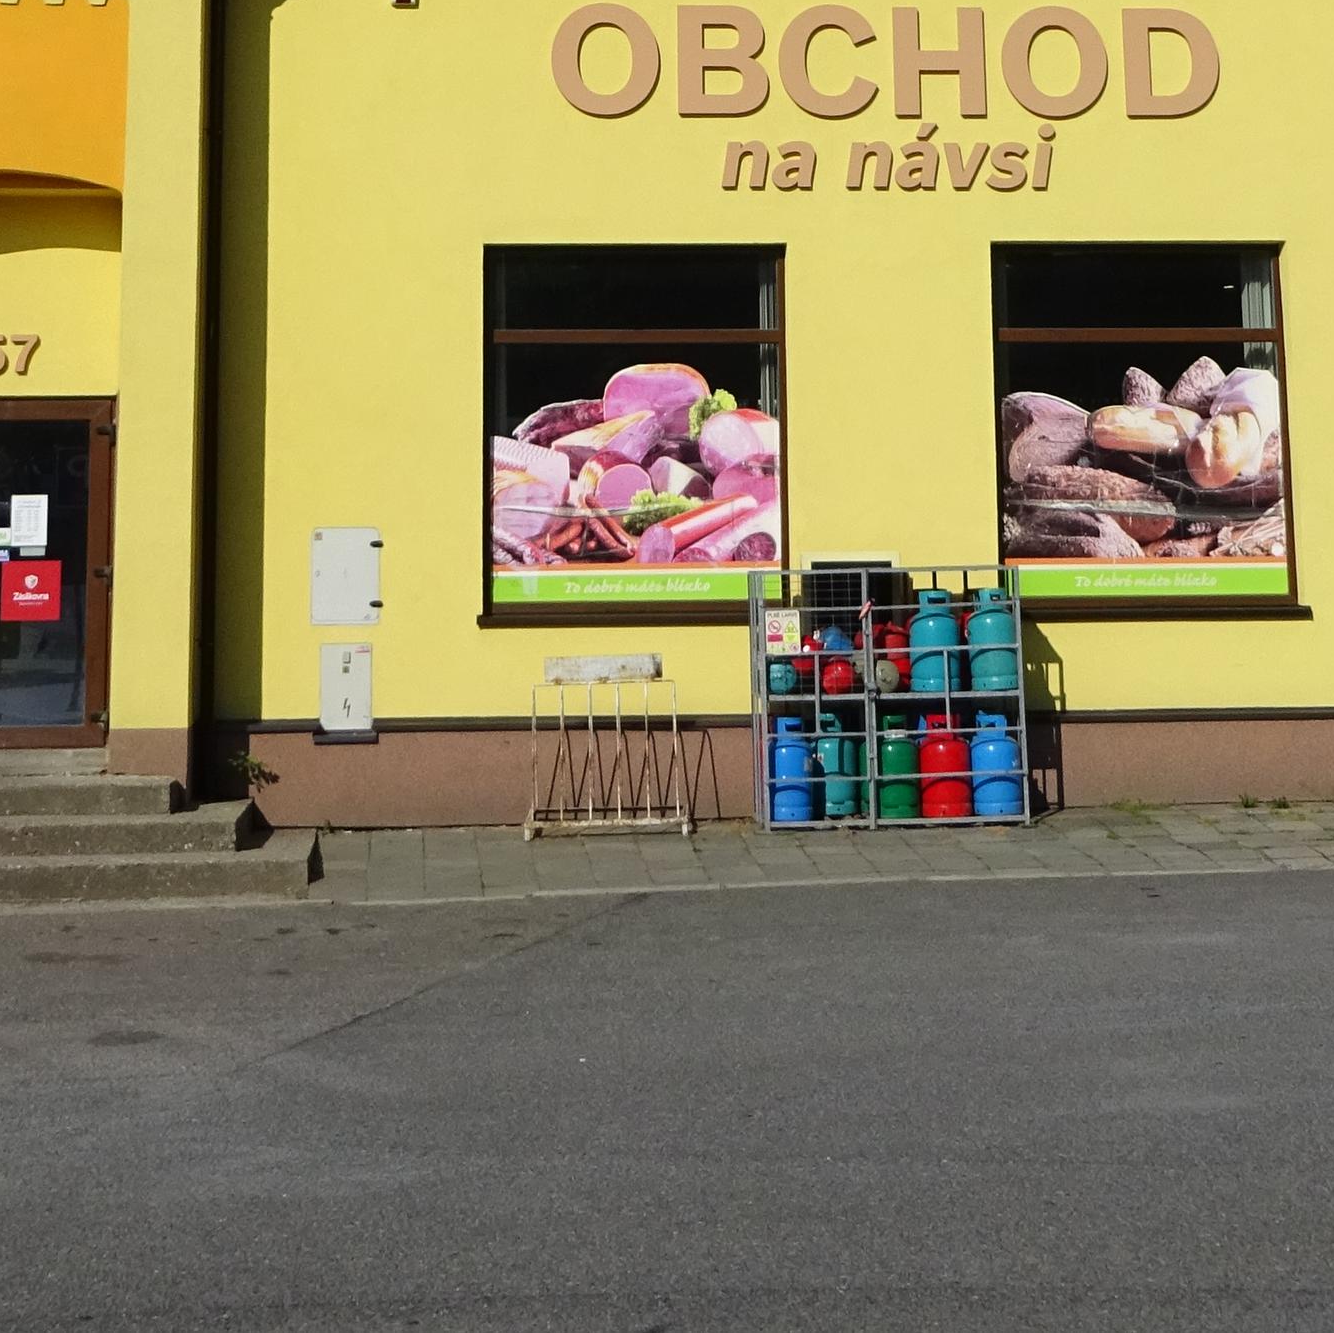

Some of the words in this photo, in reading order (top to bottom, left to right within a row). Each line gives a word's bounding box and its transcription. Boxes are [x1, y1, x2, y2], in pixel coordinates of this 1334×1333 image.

[551, 2, 1220, 120] OBCHOD
[721, 137, 818, 191] na
[845, 123, 1057, 191] návsi
[565, 581, 581, 593] To
[1074, 576, 1091, 587] To
